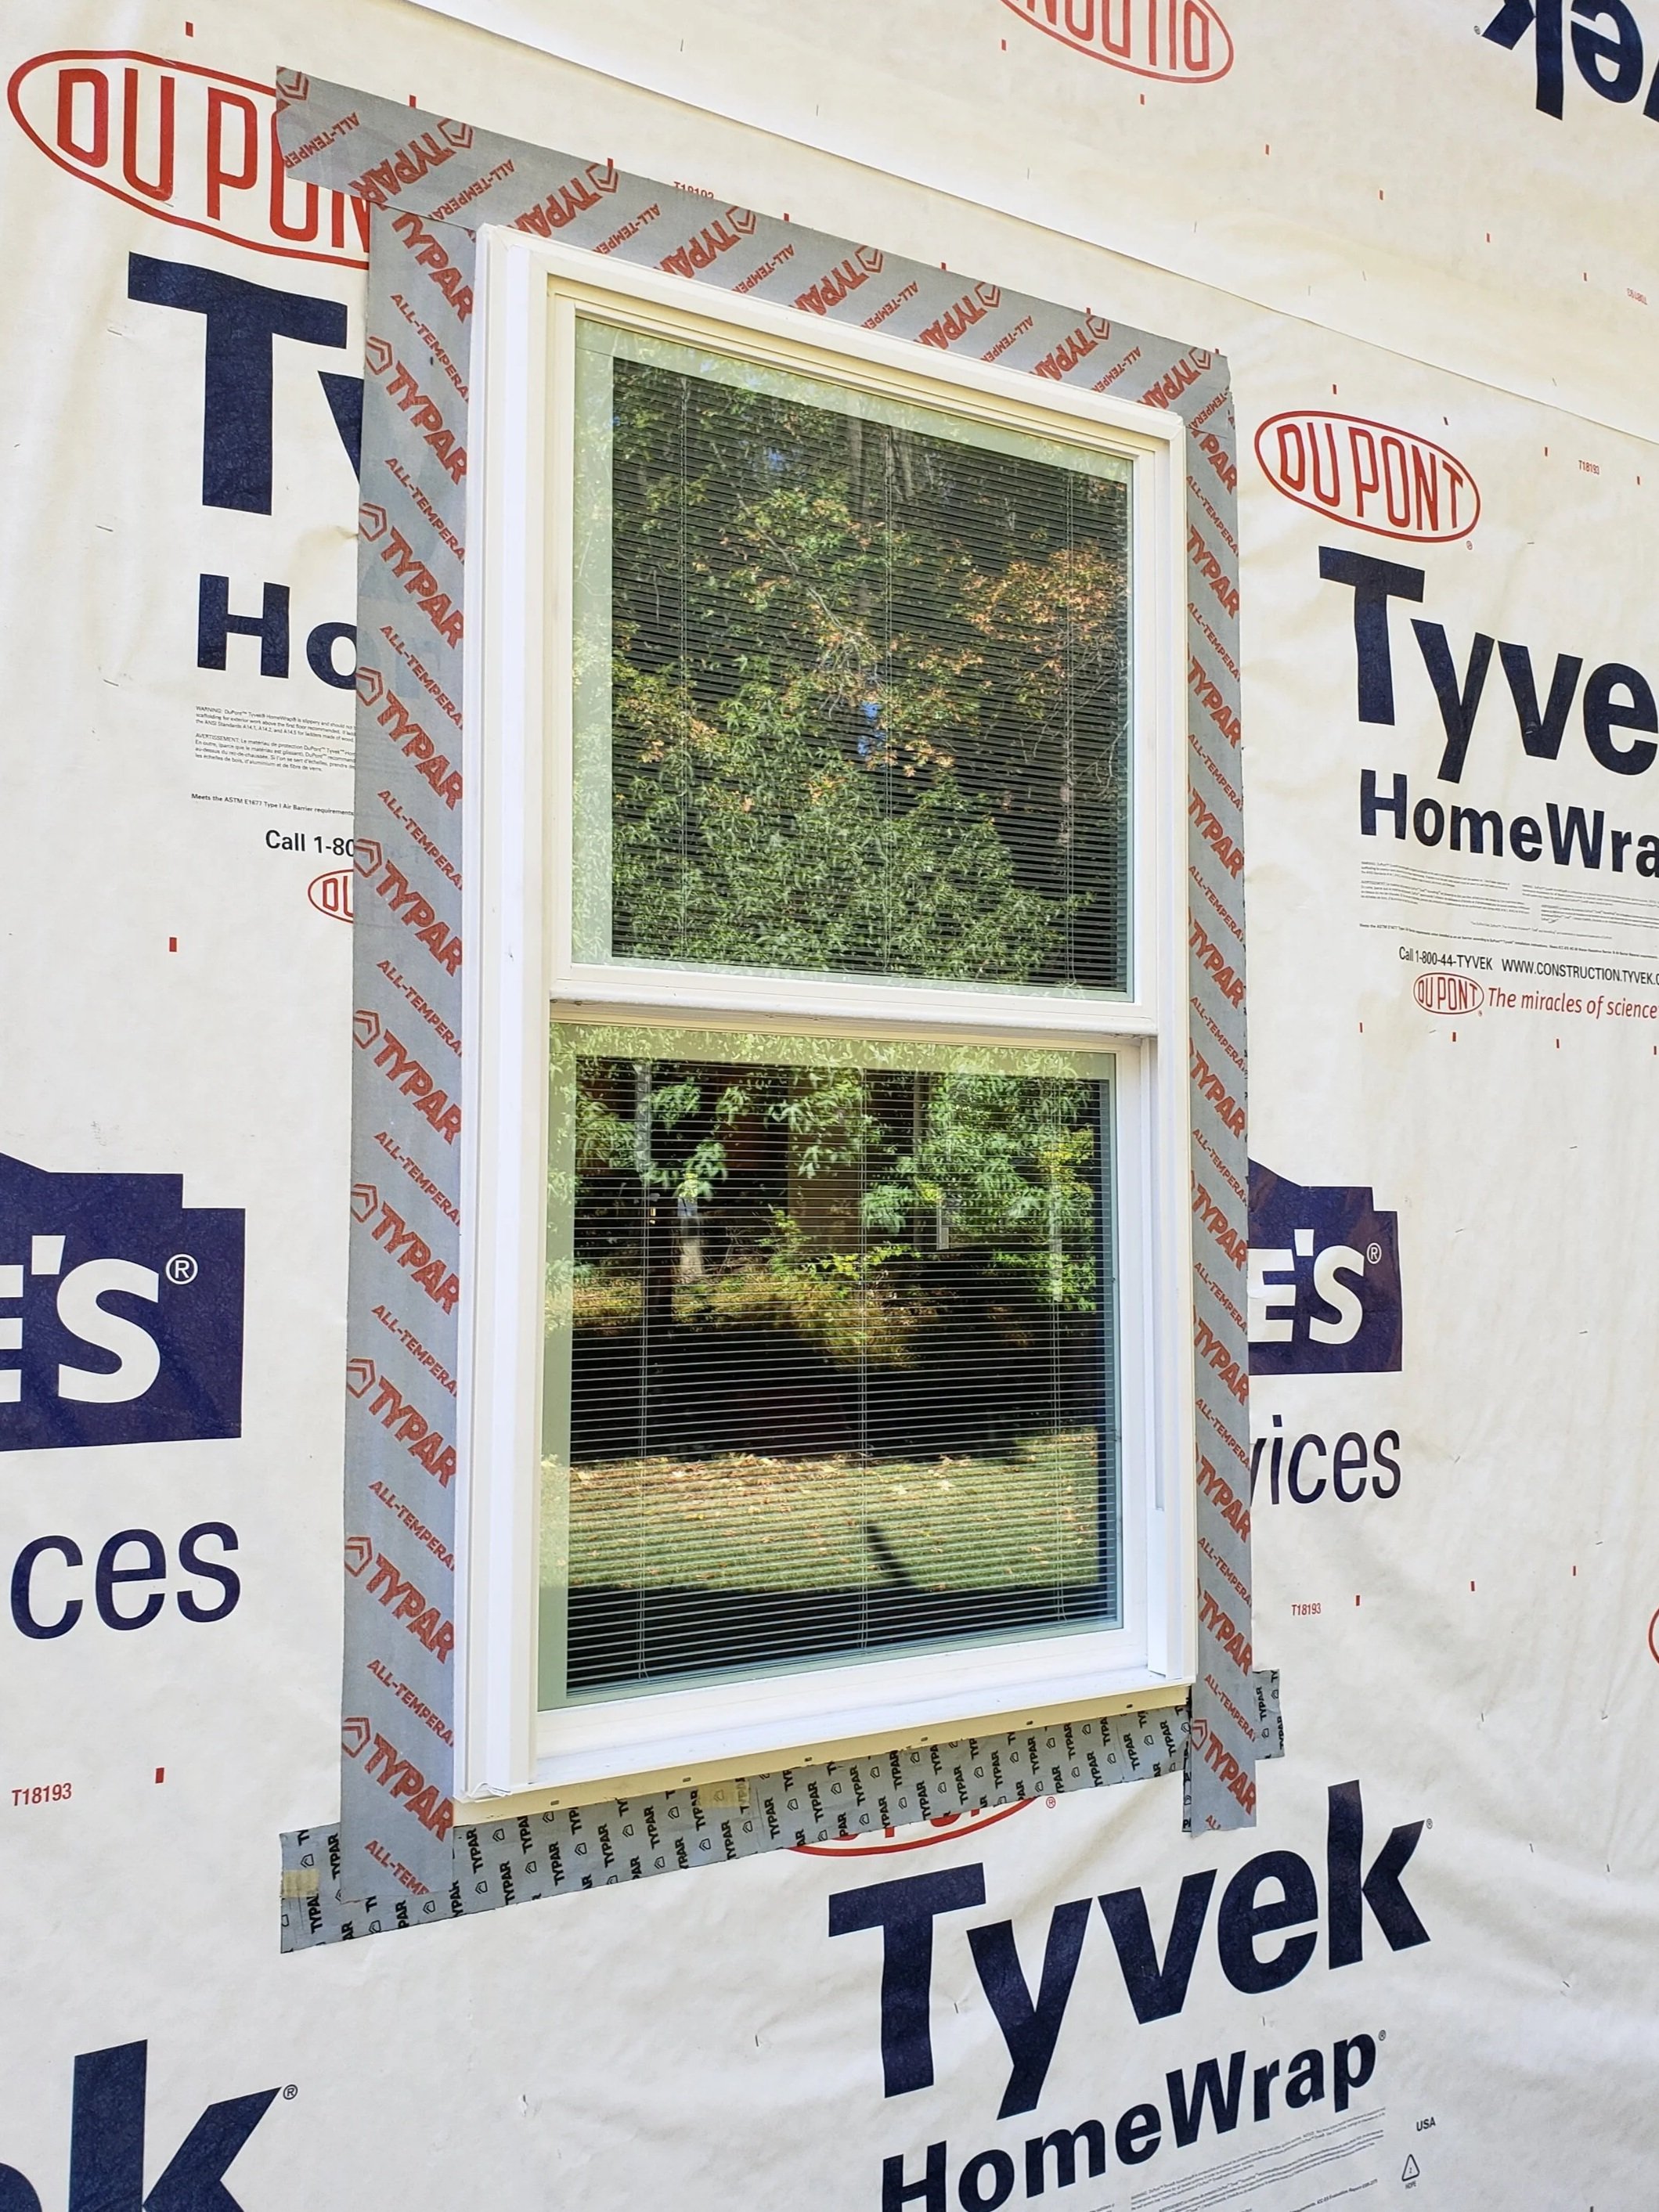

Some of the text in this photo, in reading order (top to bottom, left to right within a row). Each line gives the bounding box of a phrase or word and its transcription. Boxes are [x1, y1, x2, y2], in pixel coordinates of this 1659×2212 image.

[1481, 0, 1659, 123] ek
[348, 131, 457, 211] TYPAR
[428, 158, 515, 221] ALL-TEMPERA
[390, 294, 469, 402] ALL-TEMPERA
[386, 360, 469, 485] TYPAR
[1578, 459, 1599, 475] T18193
[385, 457, 465, 564] ALL-TEMPERA
[1186, 474, 1239, 557] ALL-TEMPERA
[380, 526, 464, 650] TYPAR
[1188, 524, 1239, 620] TYPAR
[380, 625, 463, 730] ALL-TEMPERA
[1188, 602, 1241, 683] ALL-TEMPERA
[1188, 654, 1241, 749] TYPAR
[377, 689, 463, 811] TYPAR
[1188, 733, 1243, 812] ALL-TEMPERA
[265, 830, 305, 852] Call
[377, 790, 463, 891] ALL-TEMPERA
[1188, 787, 1244, 881] TYPAR
[376, 859, 463, 977] TYPAR
[1189, 865, 1244, 942] ALL-TEMPERA
[1188, 918, 1245, 1009] TYPAR
[1399, 946, 1414, 962] Call
[1416, 949, 1493, 971] 1-800-44-TYVEK
[377, 960, 462, 1057] ALL-TEMPERA
[1190, 996, 1246, 1072] ALL-TEMPERA
[1488, 987, 1517, 1008] The
[1520, 990, 1582, 1014] miracles
[1586, 995, 1605, 1020] of
[373, 1029, 461, 1146] TYPAR
[1191, 1050, 1246, 1139] TYPAR
[373, 1132, 460, 1227] ALL-TEMPERA
[1192, 1128, 1246, 1205] ALL-TEMPERA
[371, 1201, 460, 1316] TYPAR
[1192, 1183, 1247, 1271] TYPAR
[1194, 1262, 1247, 1335] ALL-TEMPERA
[371, 1305, 457, 1397] ALL-TEMPERA
[1194, 1317, 1249, 1406] TYPAR
[369, 1375, 457, 1490] TYPAR
[1196, 1398, 1250, 1471] ALL-TEMPERA
[369, 1481, 455, 1571] ALL-TEMPERA
[1196, 1454, 1250, 1543] TYPAR
[10, 1521, 241, 1640] ces
[366, 1552, 455, 1664] TYPAR
[1198, 1537, 1252, 1608] ALL-TEMPERA
[1291, 1602, 1322, 1616] T18193
[1198, 1590, 1252, 1676] TYPAR
[366, 1659, 454, 1747] ALL-TEMPERA
[1063, 1723, 1077, 1760] TYPAR
[1159, 1720, 1177, 1758] TYPAR
[1204, 1673, 1255, 1742] ALL-TEMPERA
[1256, 1686, 1267, 1722] TYPAR
[364, 1732, 454, 1843] TYPAR
[849, 1764, 866, 1807] TYPAR
[889, 1750, 903, 1790] TYPAR
[954, 1764, 969, 1806] TYPAR
[990, 1750, 1004, 1789] TYPAR
[1027, 1736, 1040, 1775] TYPAR
[1123, 1732, 1141, 1771] TYPAR
[1204, 1731, 1256, 1815] TYPAR
[11, 1782, 73, 1807] T18193
[644, 1805, 661, 1850] TYPAR
[764, 1796, 781, 1839] TYPAR
[808, 1780, 824, 1824] TYPAR
[916, 1780, 932, 1821] TYPAR
[327, 1832, 341, 1880] TYPAR
[467, 1827, 484, 1875] TYPAR
[518, 1815, 533, 1854] TYPA
[549, 1841, 565, 1886] TYPAR
[597, 1823, 615, 1868] TYPAR
[1416, 2117, 1436, 2131] USA
